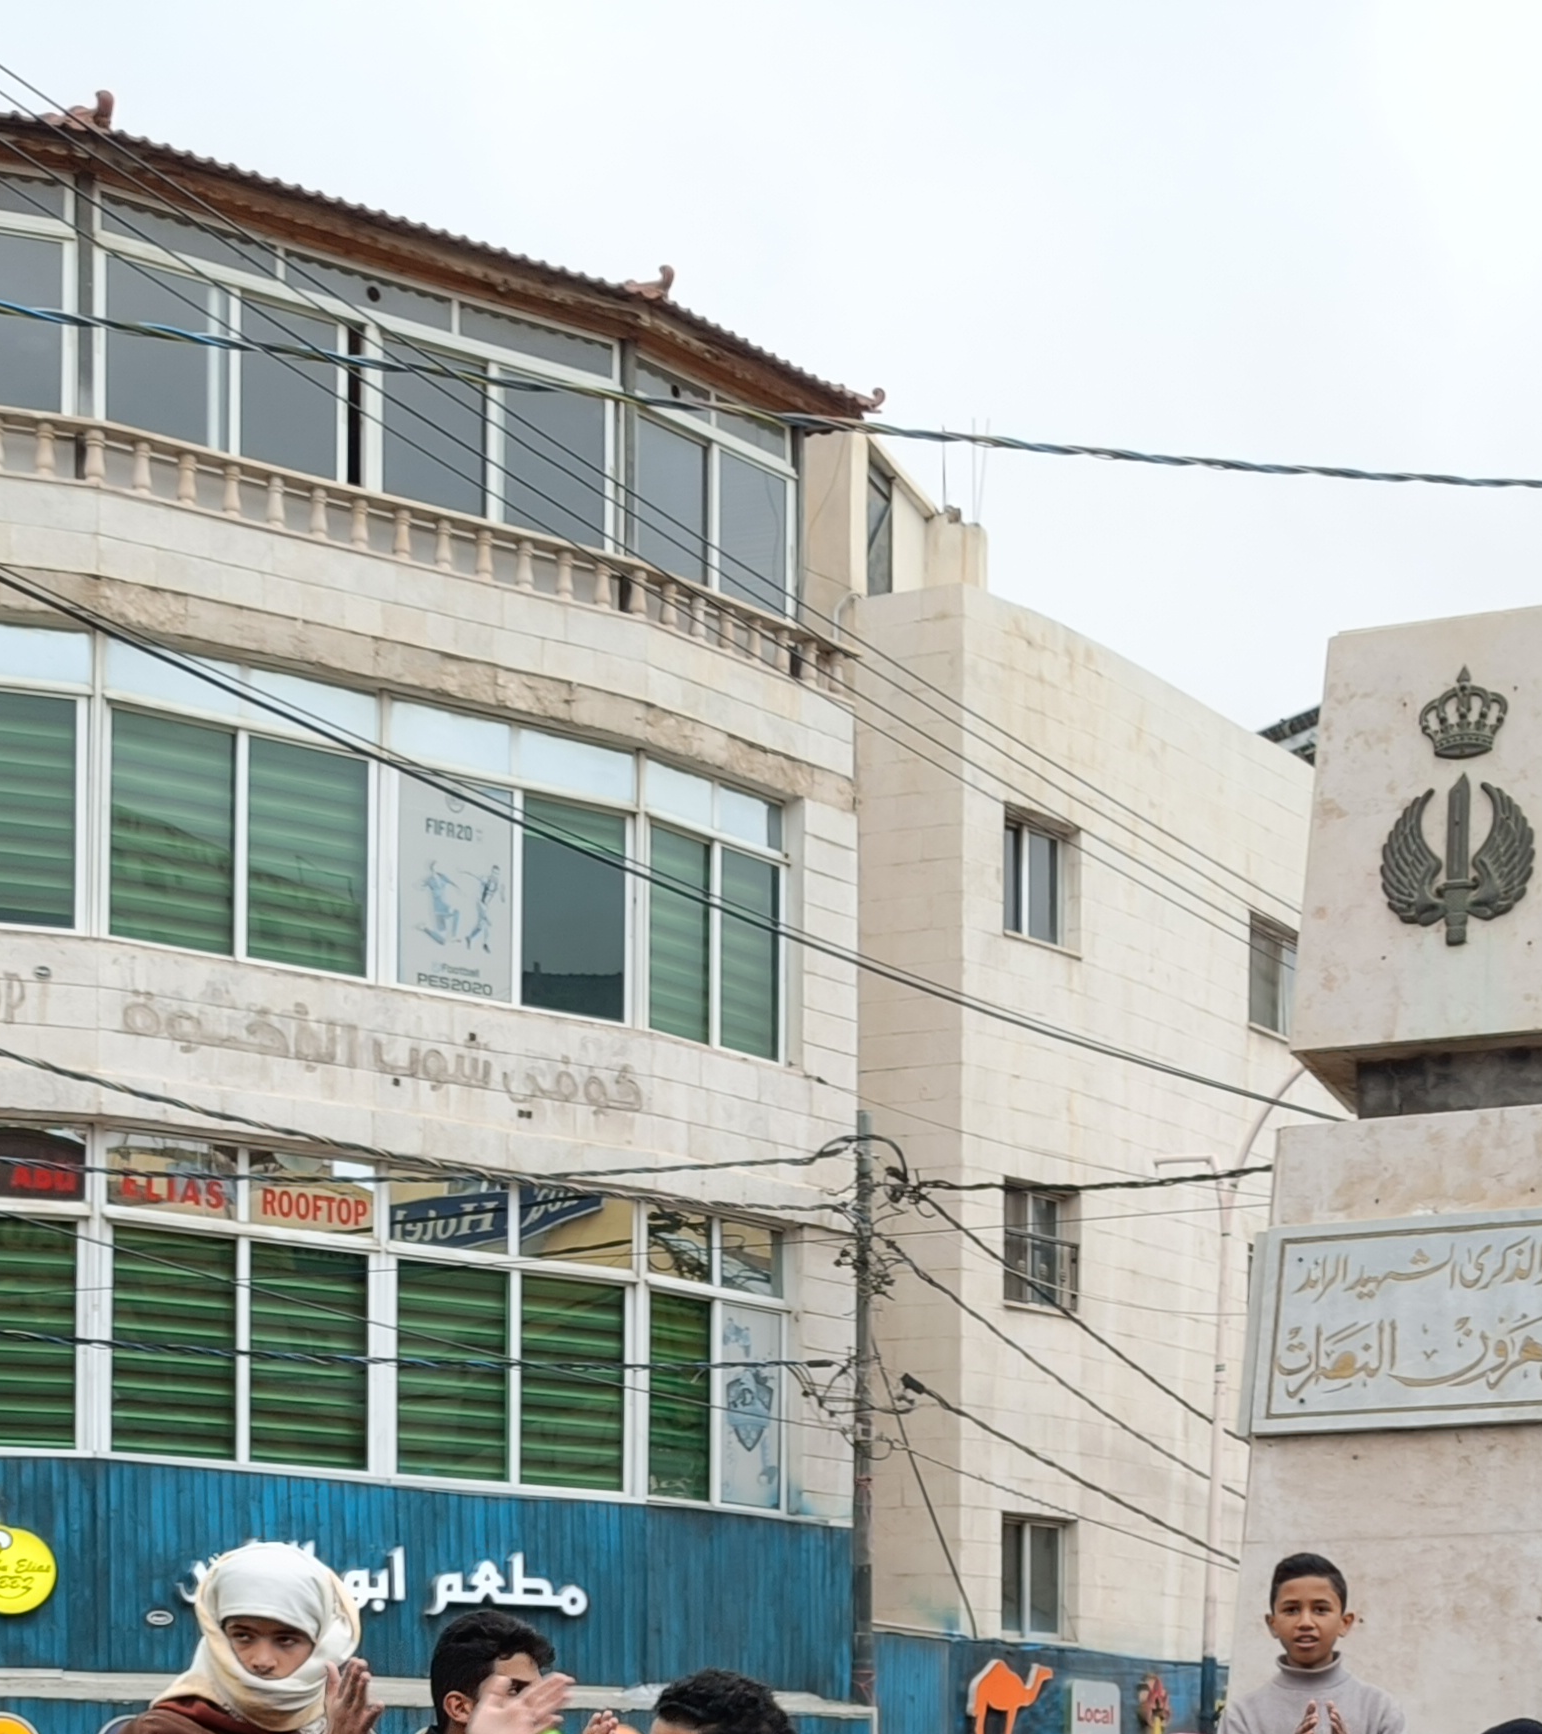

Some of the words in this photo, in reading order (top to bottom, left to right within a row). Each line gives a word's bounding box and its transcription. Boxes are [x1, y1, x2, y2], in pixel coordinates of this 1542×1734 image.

[119, 1167, 225, 1212] ELIAS
[260, 1186, 369, 1226] ROOFTOP
[14, 1558, 52, 1574] Elias
[425, 1552, 589, 1617] مطعم
[1076, 1702, 1115, 1726] Local
